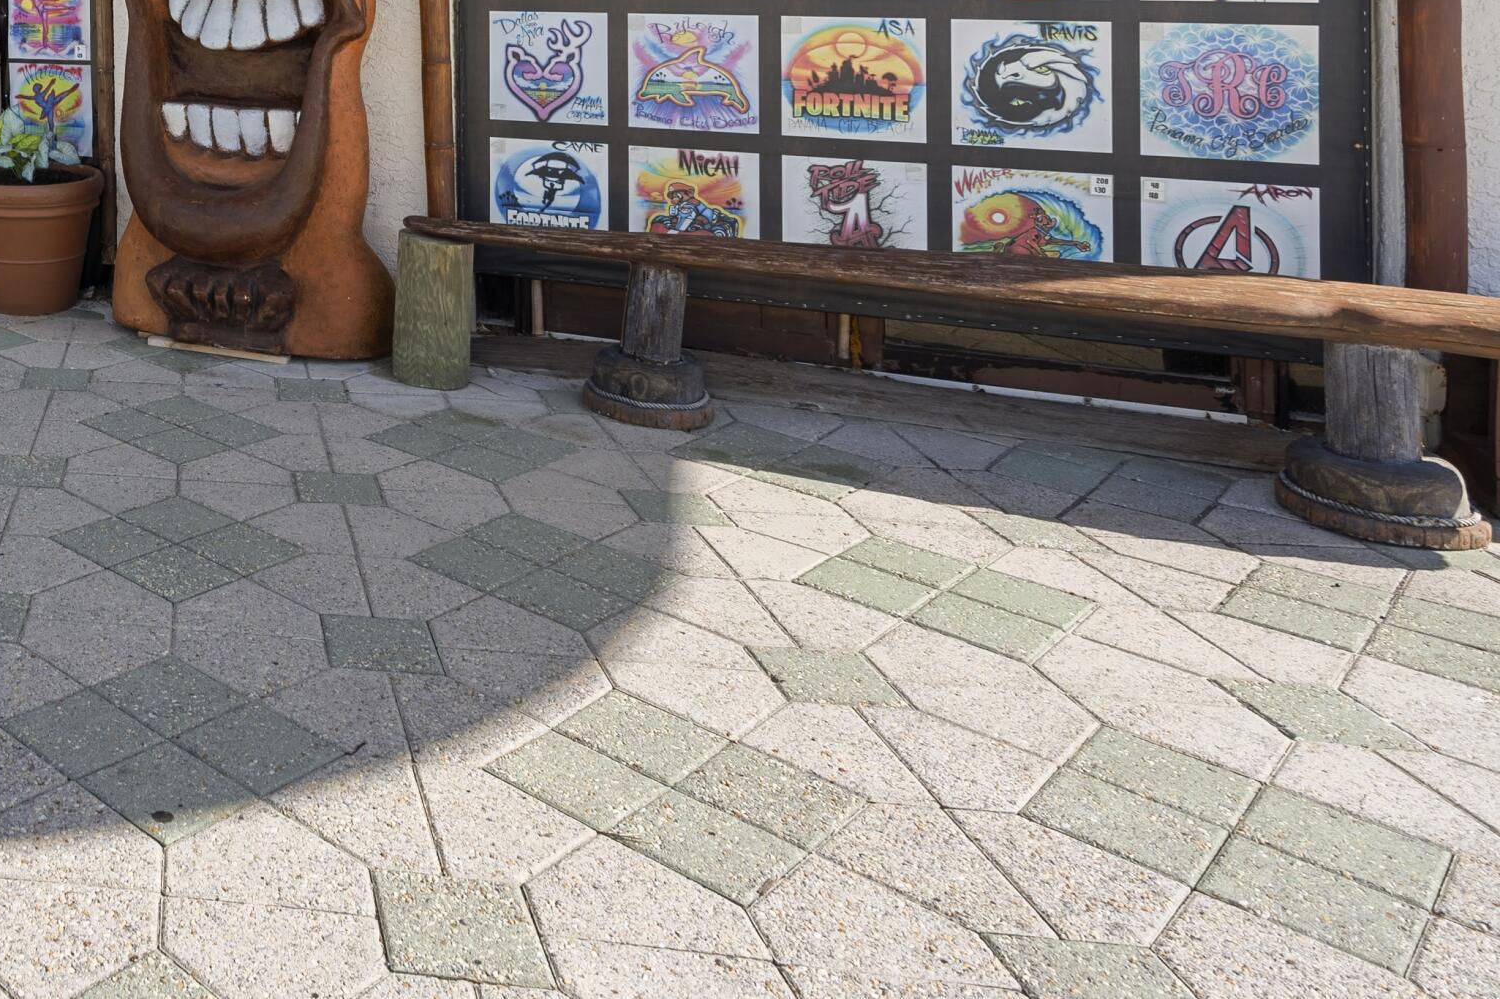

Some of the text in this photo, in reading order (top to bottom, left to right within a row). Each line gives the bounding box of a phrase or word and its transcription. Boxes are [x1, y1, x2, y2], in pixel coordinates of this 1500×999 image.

[876, 18, 915, 39] ASA
[632, 102, 757, 131] Panama City Beach
[793, 89, 911, 123] FORTNITE
[1150, 107, 1202, 146] Panama
[954, 168, 1013, 198] WALKER
[506, 209, 591, 230] FORTNITE
